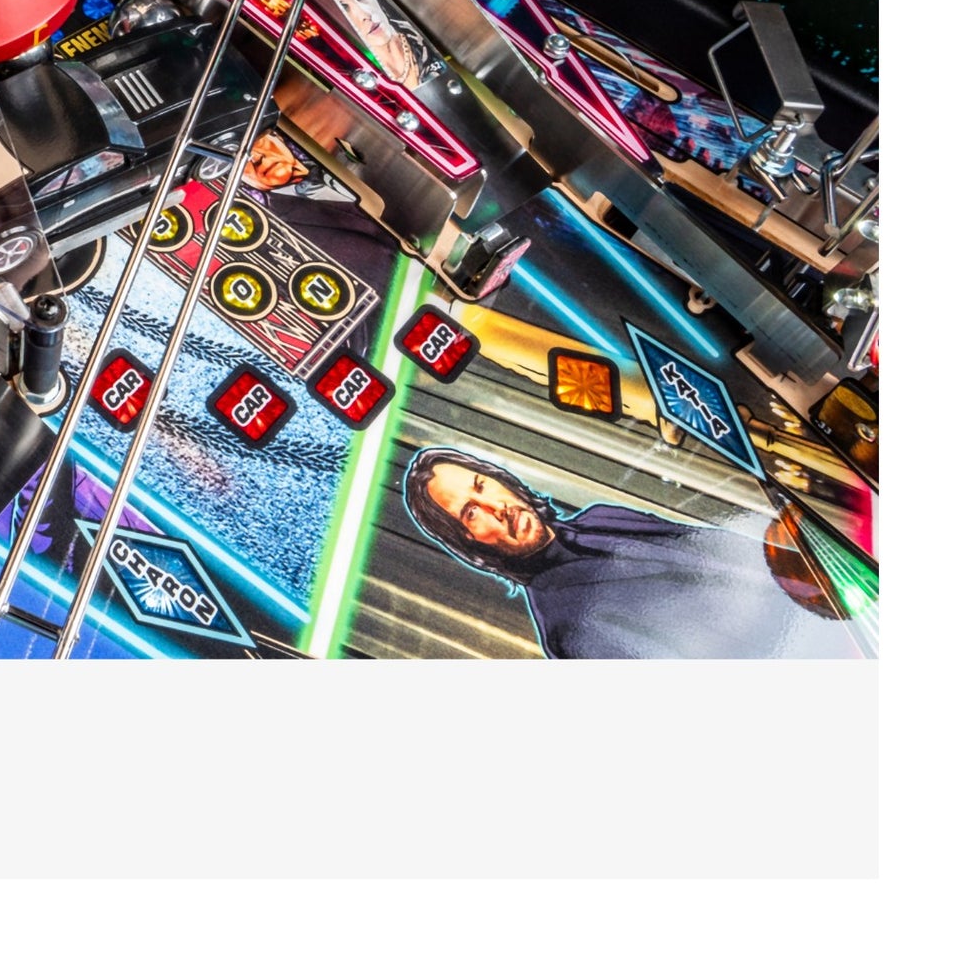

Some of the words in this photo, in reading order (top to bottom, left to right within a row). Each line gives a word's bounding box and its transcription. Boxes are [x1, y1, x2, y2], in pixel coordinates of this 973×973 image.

[225, 213, 245, 233] T
[232, 278, 253, 301] O
[307, 277, 333, 303] N
[421, 324, 455, 362] CAR
[104, 370, 142, 409] CAR
[233, 385, 270, 425] CAR
[334, 369, 369, 408] CAR
[662, 363, 729, 437] KATIA
[112, 542, 216, 624] CHARON
